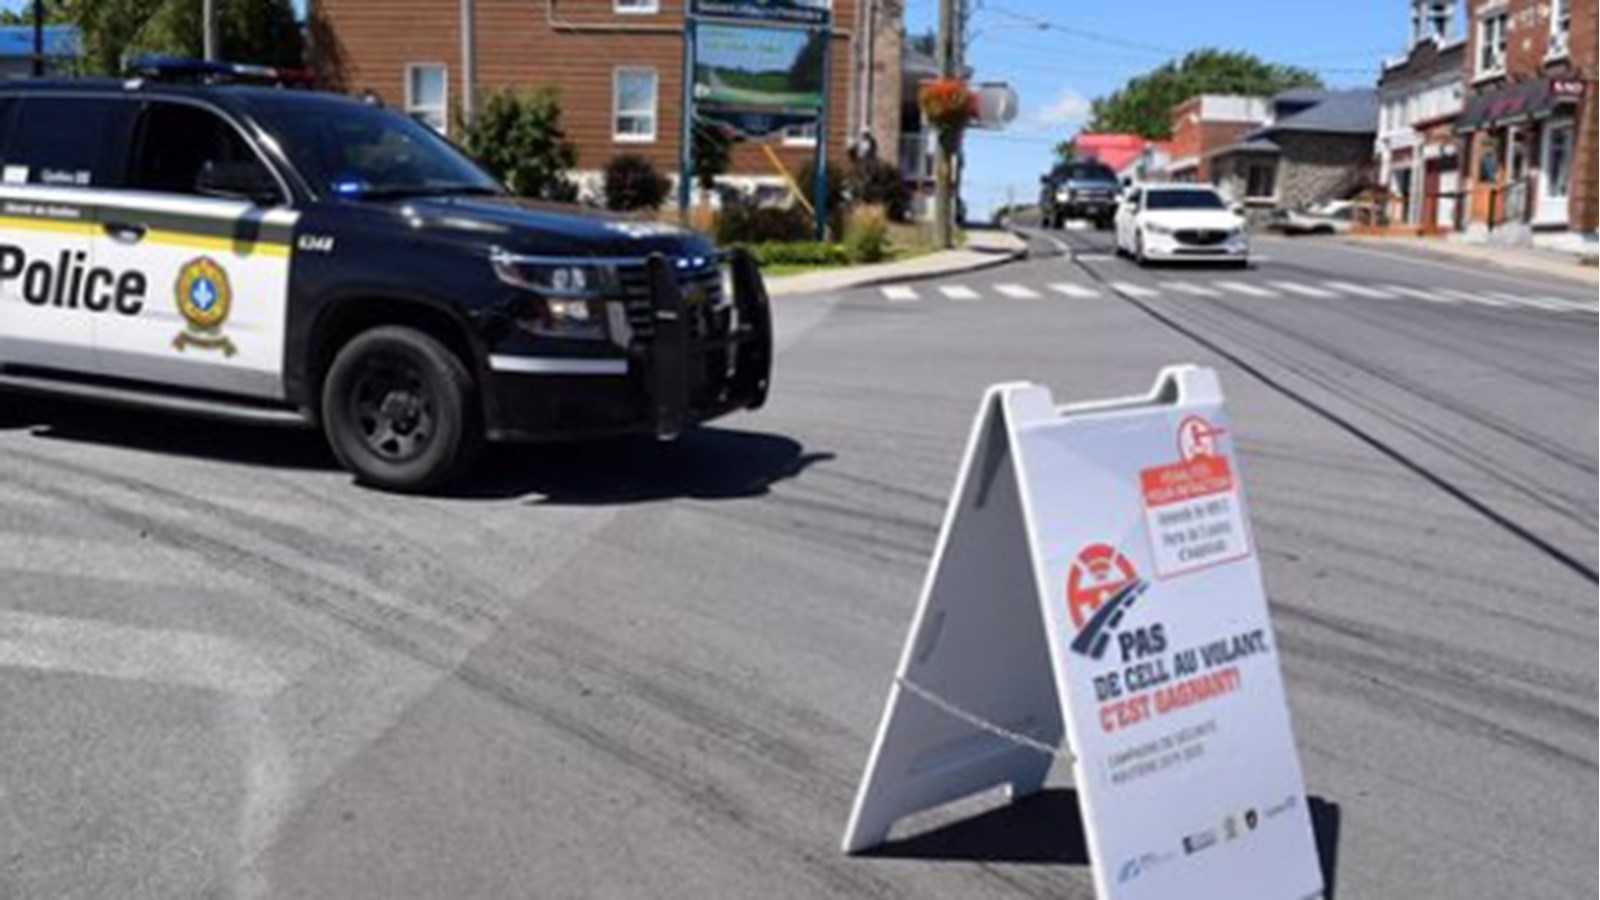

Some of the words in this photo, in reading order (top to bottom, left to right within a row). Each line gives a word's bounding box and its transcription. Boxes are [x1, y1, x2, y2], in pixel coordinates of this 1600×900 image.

[0, 245, 147, 315] Police
[1093, 672, 1121, 702] DE
[1124, 658, 1170, 693] CELL
[1173, 647, 1199, 678] AU
[1200, 629, 1269, 667] VOLANT,
[1118, 623, 1166, 662] PAS
[1099, 694, 1151, 733] C'EST
[1153, 667, 1241, 715] GAGNANT!
